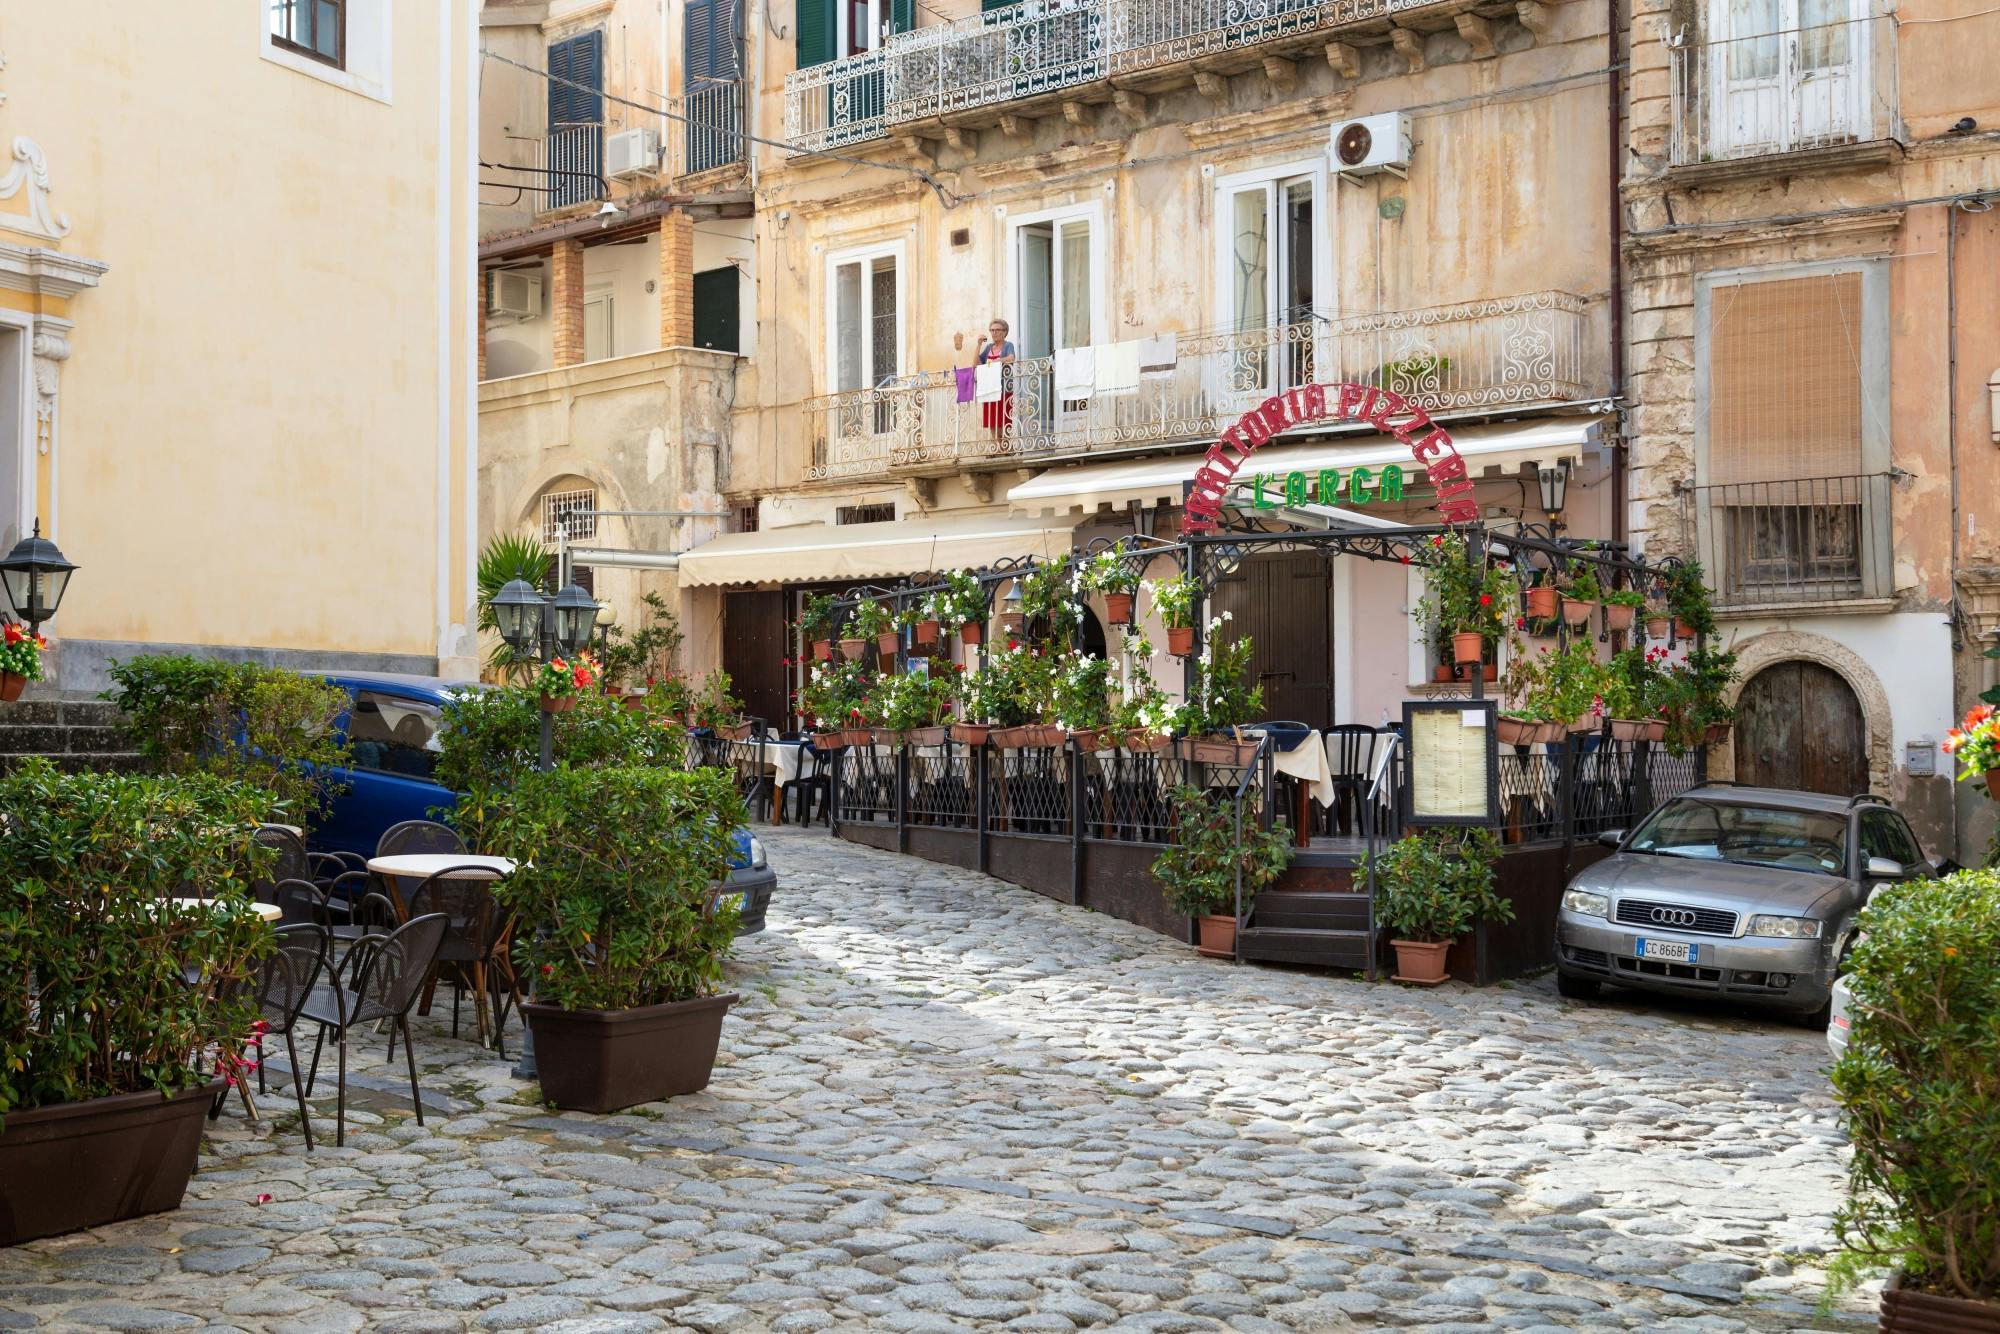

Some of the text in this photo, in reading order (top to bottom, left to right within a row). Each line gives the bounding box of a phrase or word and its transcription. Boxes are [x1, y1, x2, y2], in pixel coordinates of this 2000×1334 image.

[1182, 383, 1479, 536] TRATTORIA PIZZERIA
[1254, 465, 1403, 510] L'ARCA
[1646, 943, 1657, 954] CC
[1660, 944, 1688, 958] 866BF
